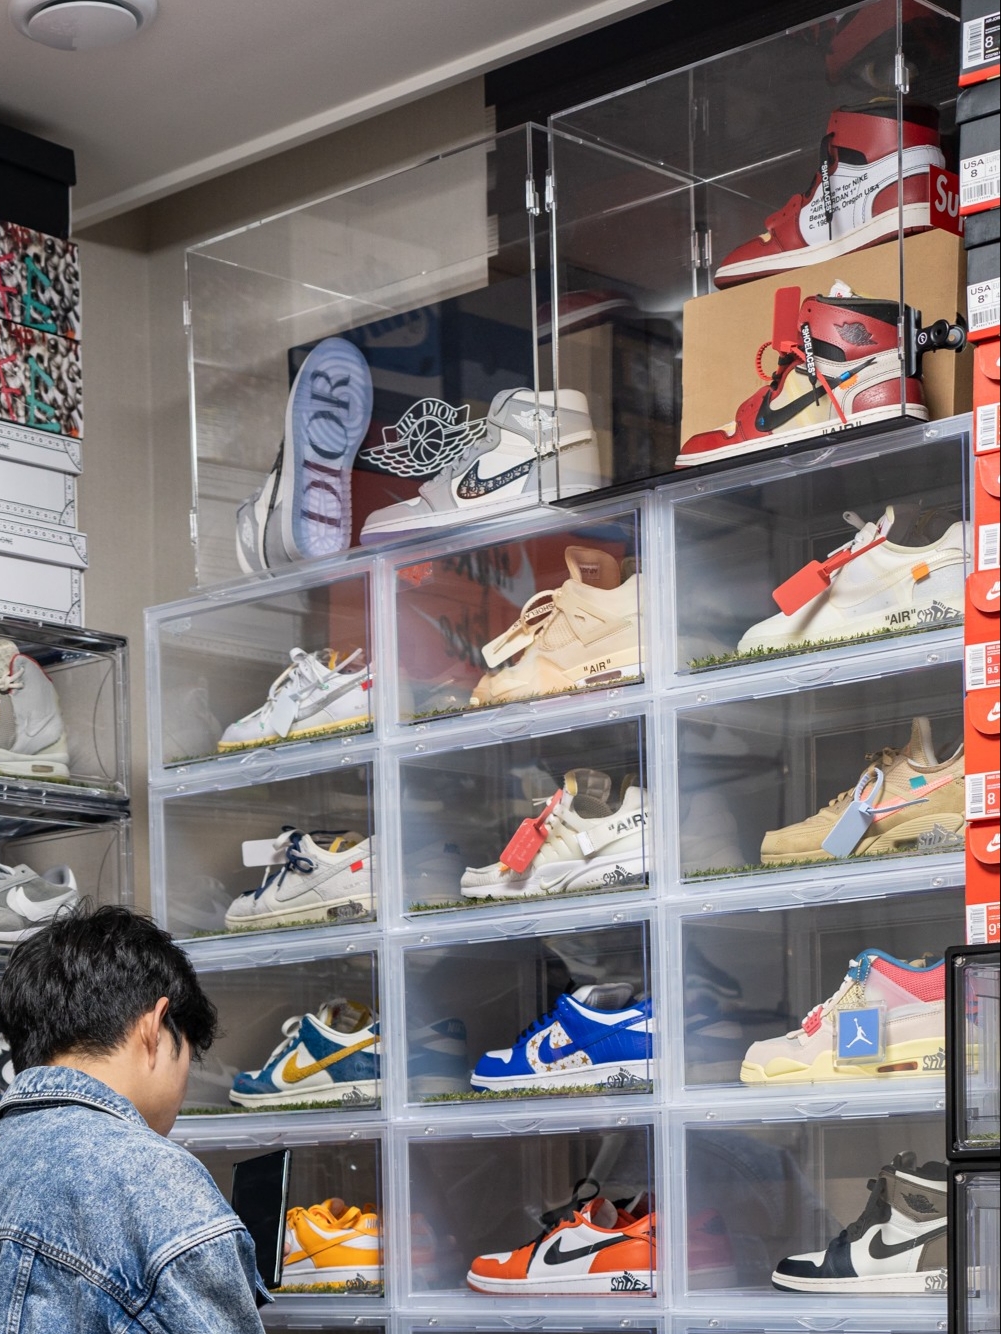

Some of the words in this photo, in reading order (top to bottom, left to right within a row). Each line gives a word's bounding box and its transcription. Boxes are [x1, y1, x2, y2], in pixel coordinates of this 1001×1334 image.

[985, 36, 993, 48] 8
[963, 159, 985, 170] USA
[852, 173, 868, 187] NIKE
[970, 169, 978, 178] 8
[970, 284, 991, 296] USA
[395, 412, 418, 439] AIR
[422, 401, 459, 426] DIOR
[301, 369, 351, 528] DIOR
[885, 608, 917, 626] "AIR"
[583, 658, 612, 675] "AIR"
[987, 792, 996, 805] 8
